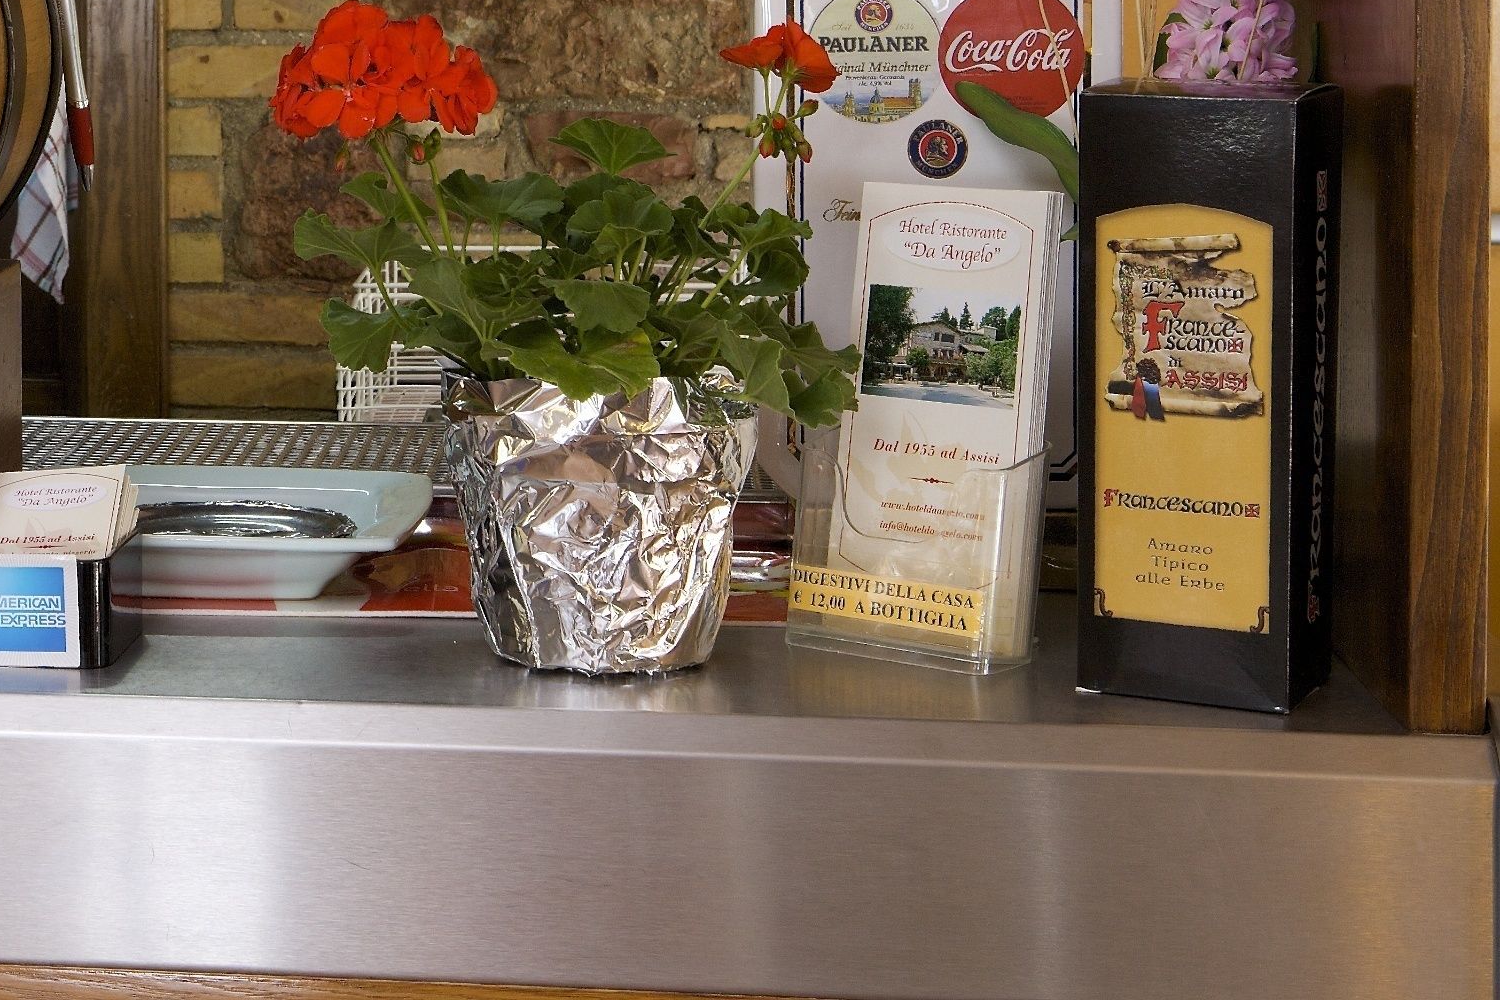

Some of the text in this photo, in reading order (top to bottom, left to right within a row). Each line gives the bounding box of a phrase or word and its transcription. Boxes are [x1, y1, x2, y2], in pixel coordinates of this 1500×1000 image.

[818, 36, 930, 53] PAULANER
[945, 28, 1075, 73] Coca-Cola
[868, 61, 931, 73] Münchner
[900, 217, 1008, 239] Hotel Ristorante
[1142, 280, 1245, 299] L'Amaro
[1142, 300, 1246, 353] France-
[1164, 335, 1228, 353] scano
[1168, 355, 1182, 367] di
[1162, 369, 1248, 392] ASSISI
[873, 438, 1000, 464] Dal 1955 ad Assisi
[14, 486, 98, 497] Hotel Ristorante
[1104, 488, 1243, 517] Francescano
[0, 533, 96, 544] Dal 1955 ad Assisi
[1148, 537, 1213, 555] Amaro
[1151, 555, 1209, 572] Tipico
[792, 569, 975, 609] DIGESTIVI DELLA CASA
[1135, 571, 1225, 591] alle Erbe
[0, 612, 67, 628] EXPRESS
[793, 590, 968, 631] € 12,00 A BOTTIGLIA
